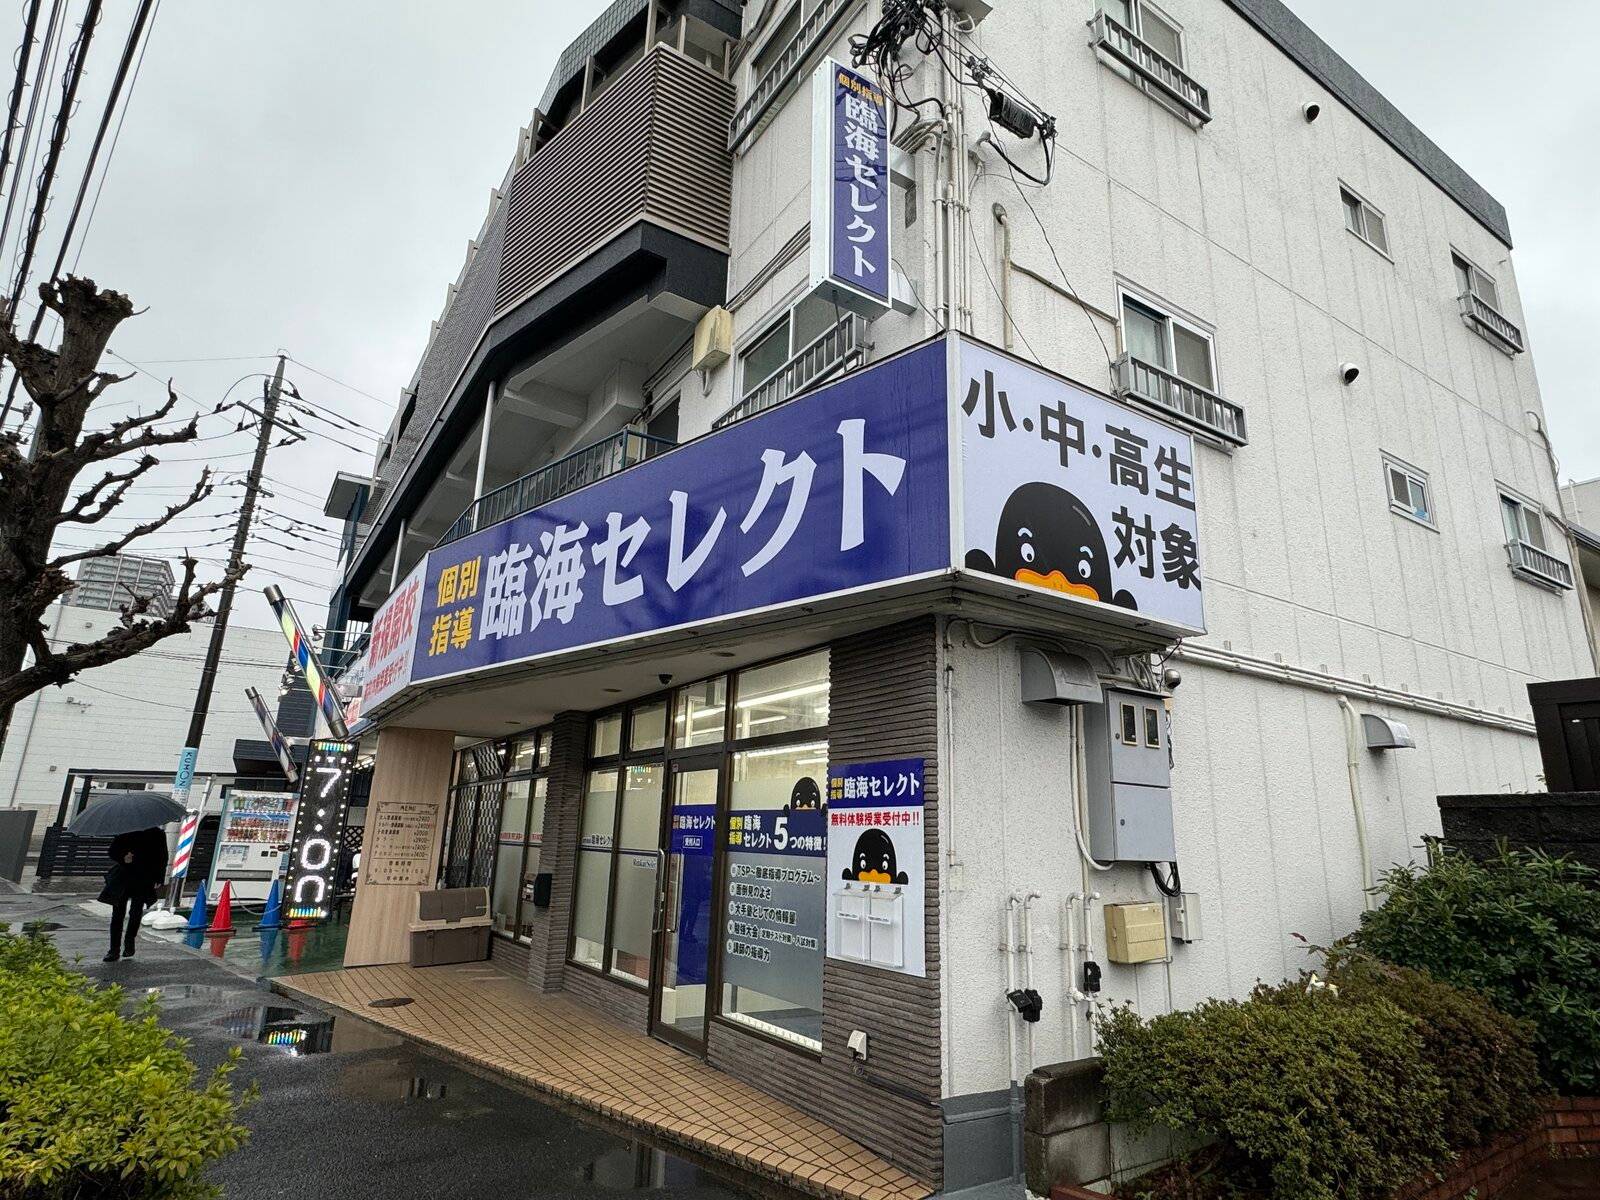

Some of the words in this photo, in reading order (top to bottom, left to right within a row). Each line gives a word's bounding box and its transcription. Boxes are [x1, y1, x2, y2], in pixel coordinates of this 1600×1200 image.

[845, 93, 879, 277] 臨海セレクト
[961, 370, 1196, 511] 小・中・高生
[479, 418, 907, 641] 臨海セレクト
[1112, 506, 1201, 591] 対象
[437, 555, 481, 608] 個別
[429, 607, 475, 657] 指導
[179, 751, 193, 787] KUMON
[844, 772, 920, 799] 臨海セレクト
[680, 815, 716, 829] 臨海セレクト
[743, 832, 772, 849] セレクト
[831, 811, 919, 826] 無料体験授業受付中!!
